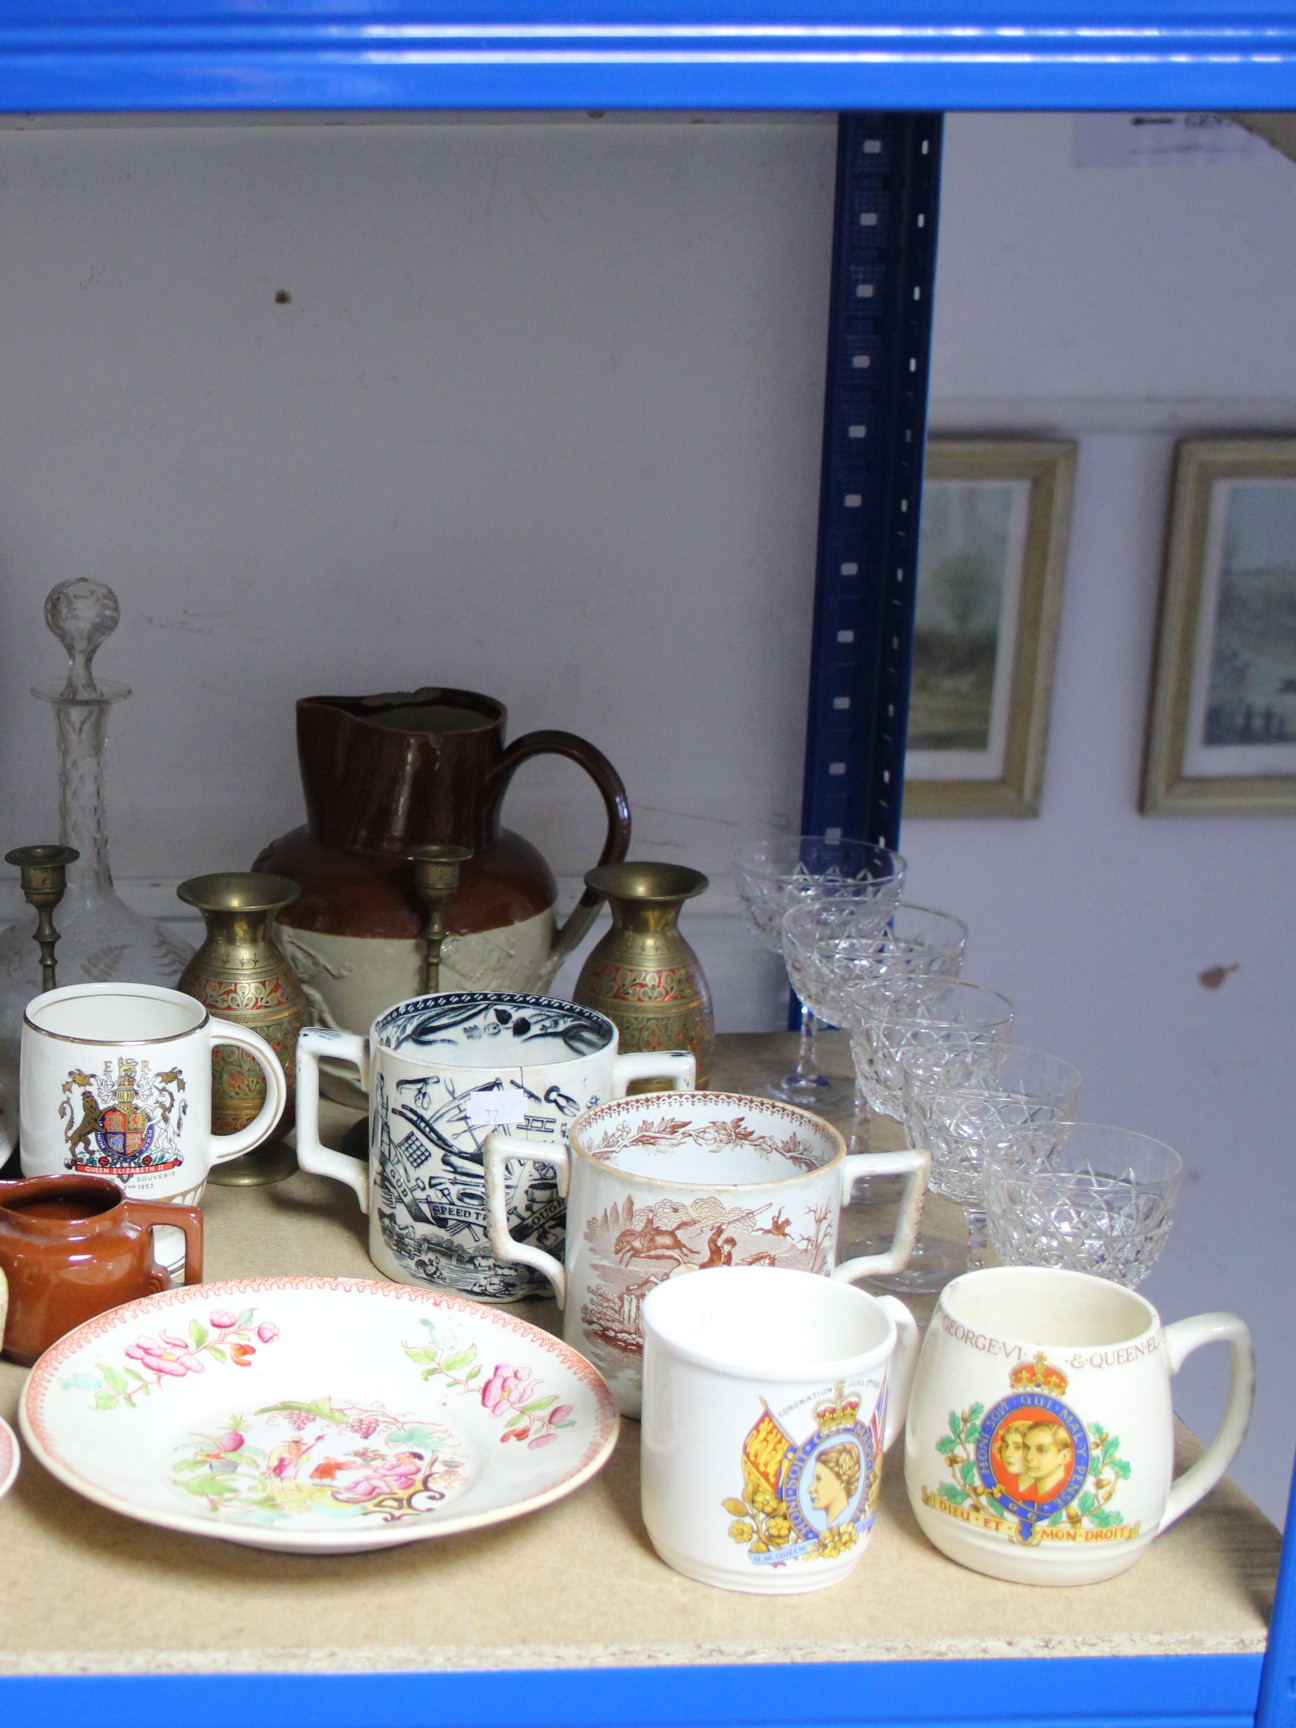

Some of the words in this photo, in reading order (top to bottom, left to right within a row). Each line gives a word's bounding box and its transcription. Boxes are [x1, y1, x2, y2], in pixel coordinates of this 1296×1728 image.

[103, 1060, 113, 1073] E
[141, 1059, 152, 1072] R
[484, 1109, 500, 1124] 32
[85, 1165, 110, 1174] QUEEN
[113, 1166, 155, 1174] ELIZABETH
[136, 1170, 176, 1183] SOUVENIR
[137, 1183, 154, 1191] 1953
[389, 1168, 409, 1198] GOD
[432, 1205, 471, 1218] SPEED
[941, 1314, 1000, 1356] GEORGE
[1070, 1353, 1084, 1369] &
[1089, 1341, 1145, 1369] QUEEN
[777, 1386, 833, 1417] CORONATION
[977, 1432, 991, 1474] HONI
[986, 1400, 1010, 1429] SOIT
[1020, 1394, 1053, 1409] QUI
[1054, 1465, 1086, 1508] PENSE
[938, 1499, 970, 1522] DIEU
[983, 1517, 1003, 1532] ET
[1040, 1530, 1077, 1541] MON
[1084, 1526, 1127, 1541] DROIT
